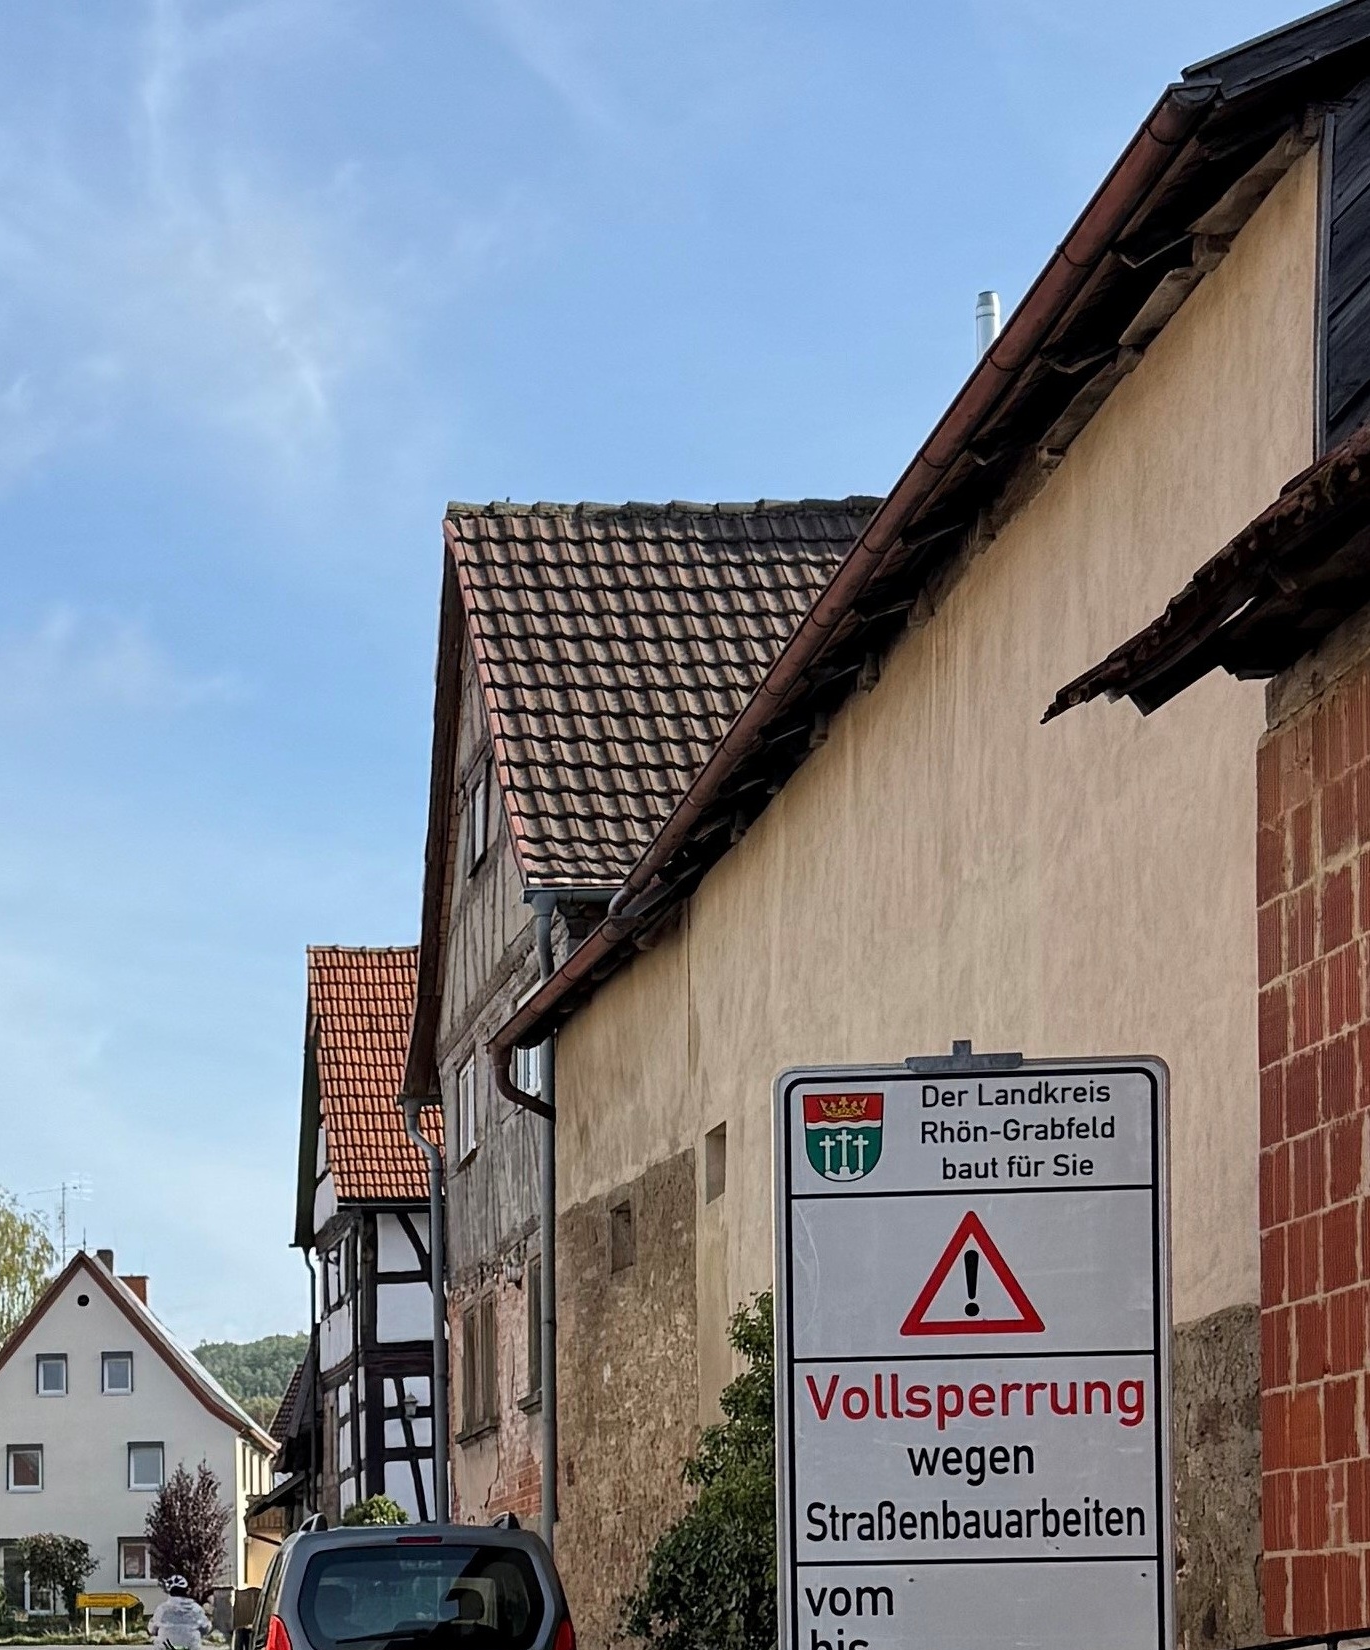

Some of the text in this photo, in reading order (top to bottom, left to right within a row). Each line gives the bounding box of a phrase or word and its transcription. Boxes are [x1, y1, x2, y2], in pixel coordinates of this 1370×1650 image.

[921, 1080, 1111, 1108] Der Landkreis
[921, 1115, 1115, 1144] Rhön-Grabfeld
[942, 1153, 1094, 1180] baut für Sie
[805, 1373, 1145, 1431] Vollsperrung
[906, 1443, 1035, 1486] wegen
[806, 1497, 1146, 1542] Straßenbauarbeiten
[805, 1584, 894, 1616] vom
